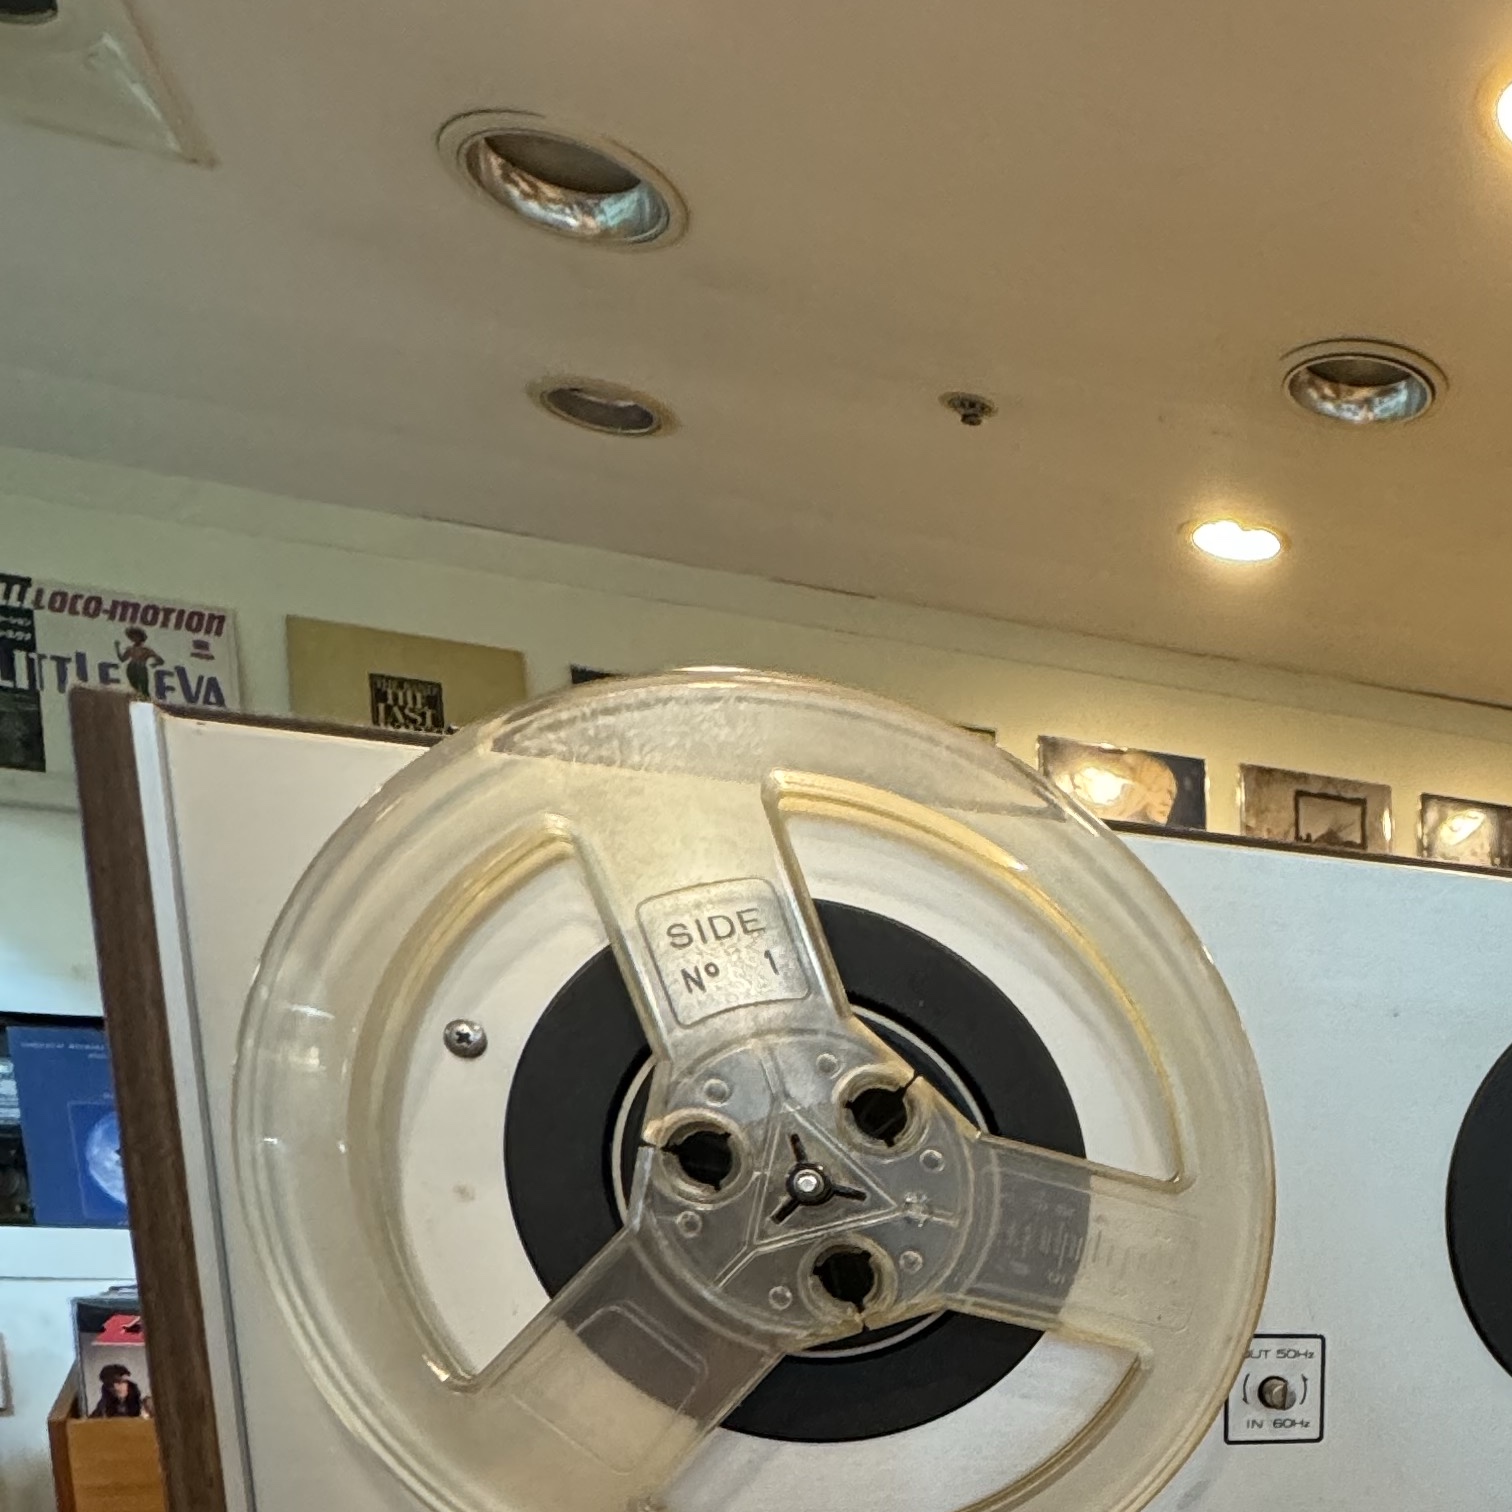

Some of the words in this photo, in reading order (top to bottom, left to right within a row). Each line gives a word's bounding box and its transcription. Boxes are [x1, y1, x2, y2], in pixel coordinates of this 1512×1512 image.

[665, 907, 767, 950] SIDE
[763, 949, 781, 976] 1
[1275, 1349, 1316, 1360] 50Hz
[1246, 1419, 1264, 1429] IN
[1272, 1418, 1311, 1429] 60Hz
